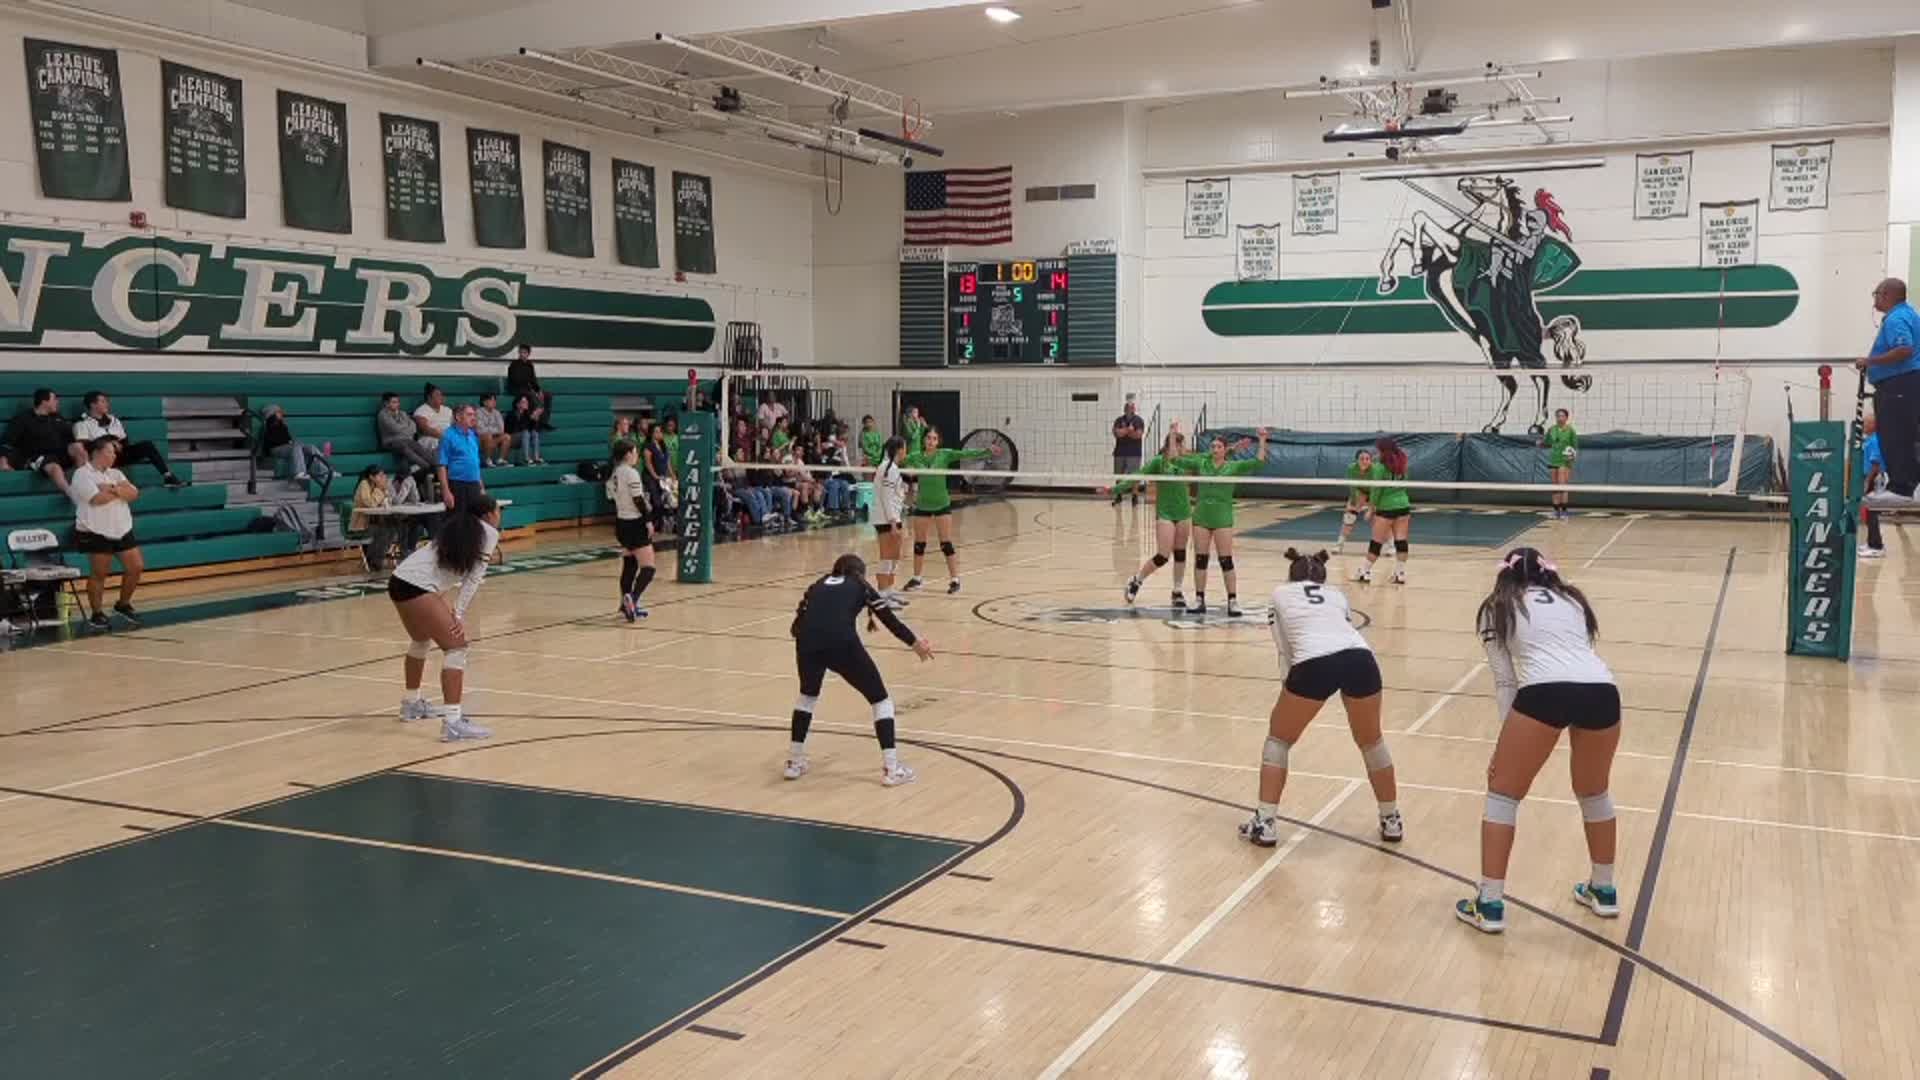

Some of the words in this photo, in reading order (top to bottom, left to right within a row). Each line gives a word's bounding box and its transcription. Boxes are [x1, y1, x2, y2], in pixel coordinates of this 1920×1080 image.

[45, 53, 103, 74] LEAGUE
[38, 67, 111, 97] CHAMPIONS
[179, 75, 227, 100] LEAGUE
[171, 89, 233, 123] CHAMPIONS
[291, 103, 334, 124] LEAGUE
[285, 115, 340, 145] CHAMPIONS
[391, 124, 430, 141] LEAGUE
[385, 136, 435, 160] CHAMPIONS
[960, 274, 977, 293] 13
[1051, 272, 1067, 290] 14
[1012, 287, 1023, 303] 5
[964, 344, 973, 358] 2
[1049, 343, 1058, 357] 2
[684, 449, 701, 575] LANCERS
[1803, 471, 1832, 642] LANCERS
[1304, 585, 1325, 605] 5
[1534, 589, 1555, 604] 3
